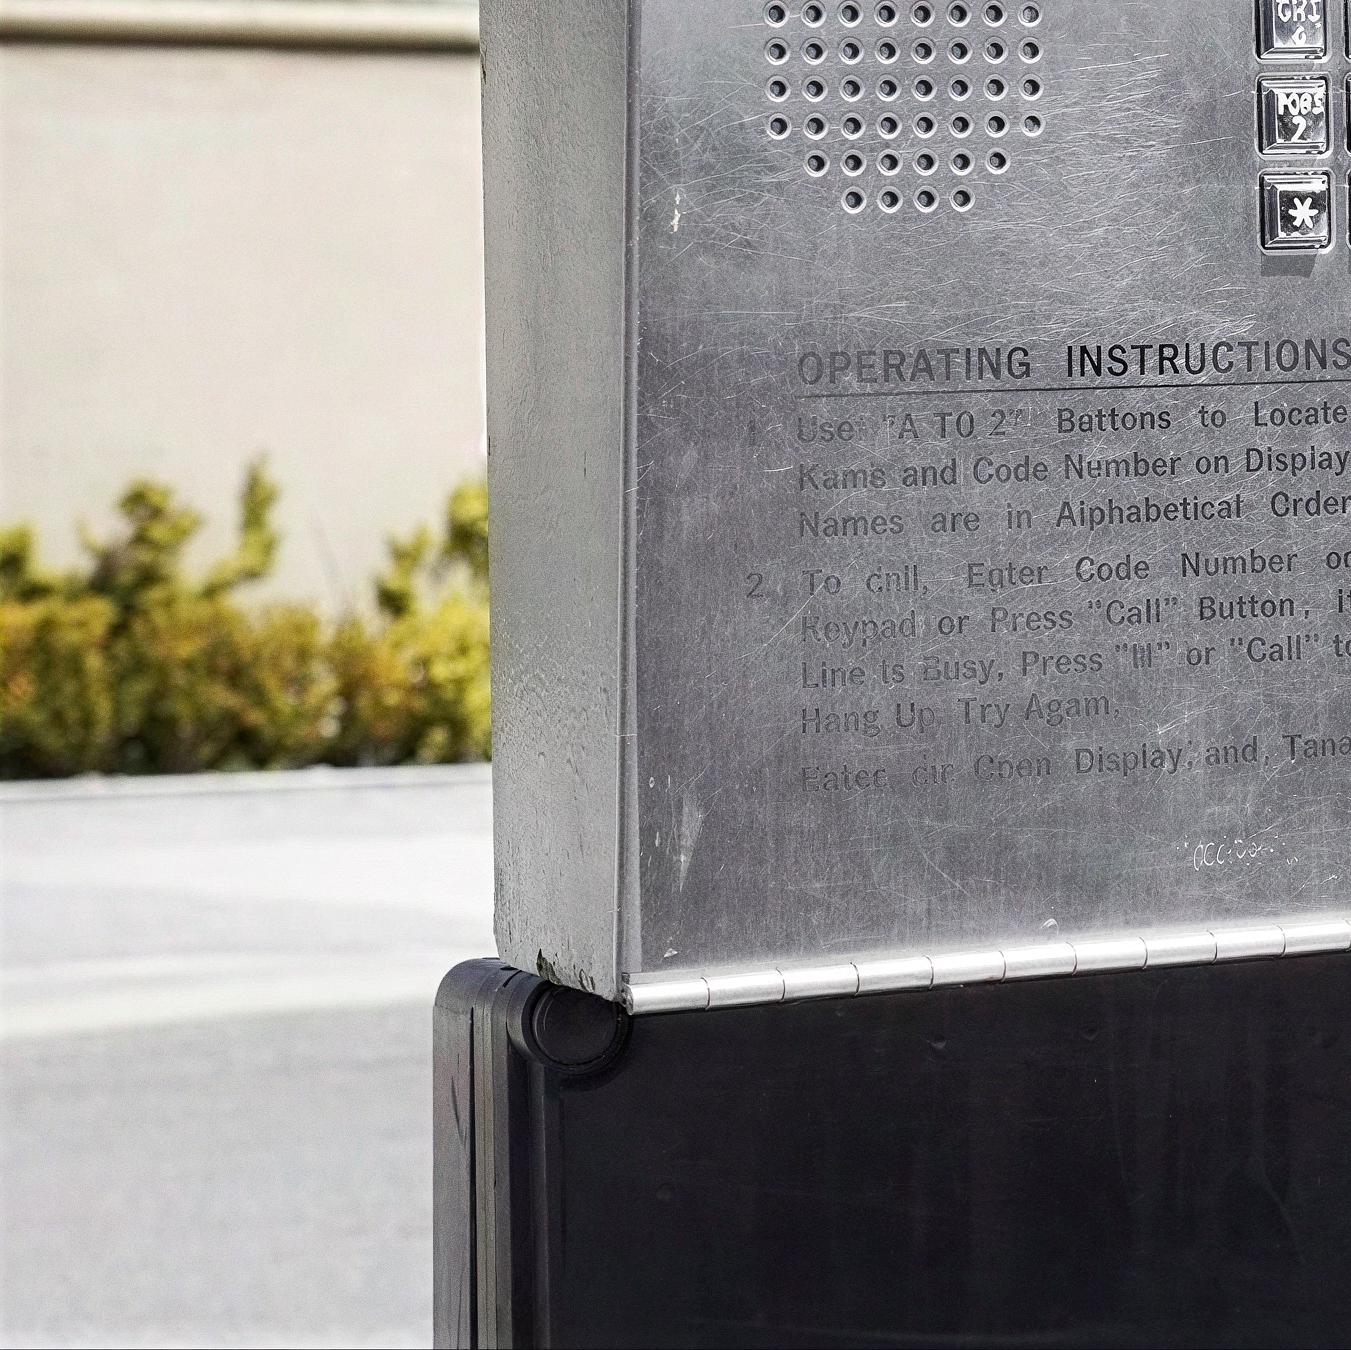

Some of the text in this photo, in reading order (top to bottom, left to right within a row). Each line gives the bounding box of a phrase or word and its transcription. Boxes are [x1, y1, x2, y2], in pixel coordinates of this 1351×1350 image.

[799, 337, 1351, 385] OPERATING INSTRUCTIONS
[932, 410, 975, 438] TO
[1200, 402, 1227, 428] to
[1253, 400, 1348, 427] Locate
[901, 458, 957, 487] and
[972, 456, 1049, 485] Code
[1195, 453, 1229, 475] on
[1245, 445, 1351, 477] Display
[799, 510, 905, 538] Names
[929, 510, 981, 534] are
[1006, 502, 1033, 530] in
[801, 568, 843, 597] To
[1075, 554, 1151, 583] Code
[1180, 548, 1299, 578] Number
[937, 614, 970, 636] or
[989, 606, 1074, 634] Press
[1021, 650, 1104, 677] Press
[1185, 645, 1217, 666] or
[801, 706, 882, 739] Hang
[895, 701, 936, 734] Up
[956, 696, 1011, 729] Try
